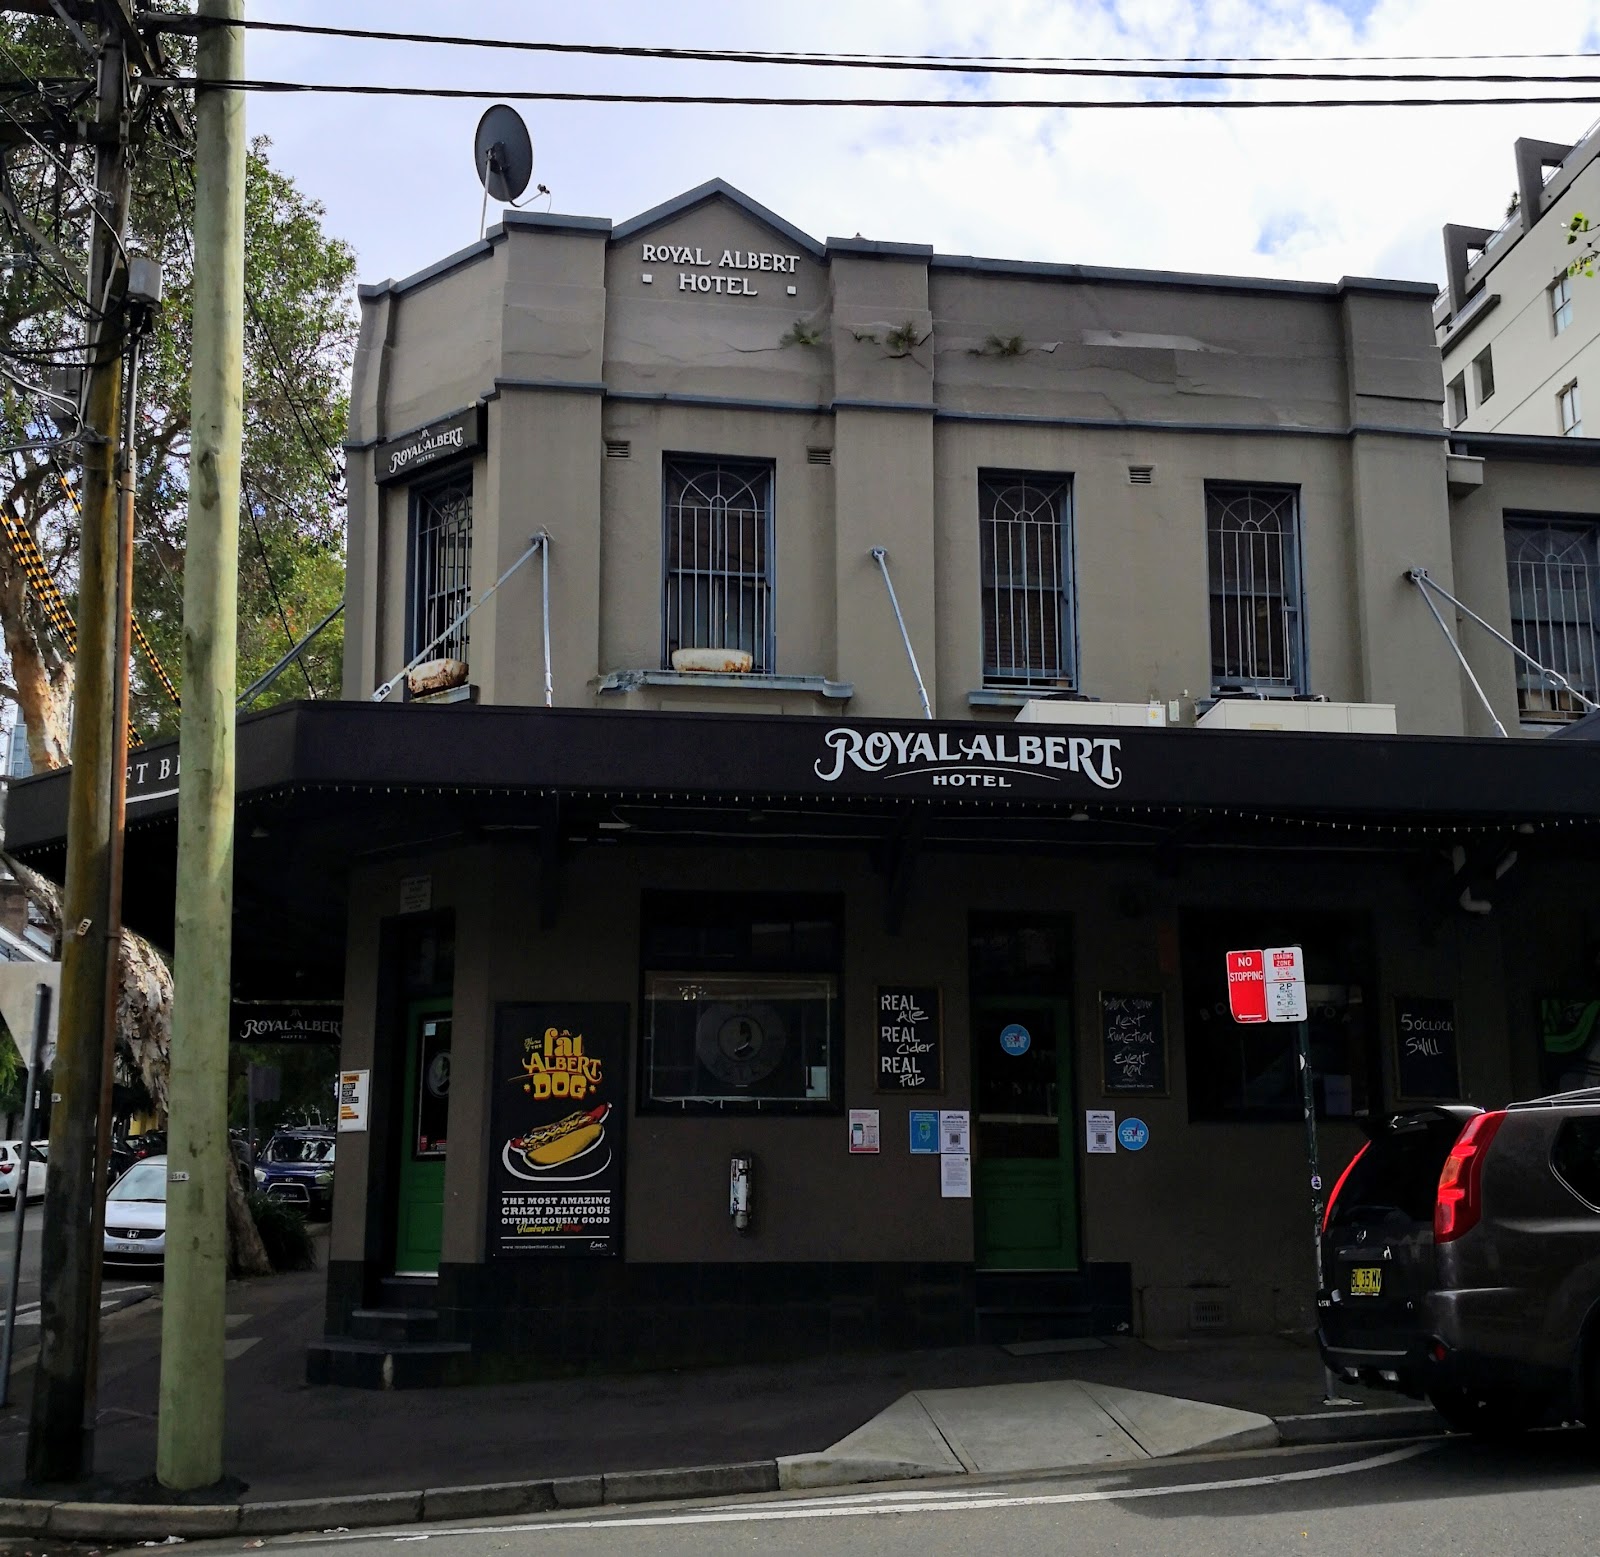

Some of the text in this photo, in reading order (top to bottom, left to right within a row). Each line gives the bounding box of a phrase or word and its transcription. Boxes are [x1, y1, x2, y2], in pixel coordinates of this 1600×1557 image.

[642, 244, 801, 273] ROYAL ALBERT
[678, 273, 758, 296] HOTEL
[389, 426, 464, 474] ROYAL ALBERT
[813, 727, 1122, 789] ROYAL ALBERT
[932, 774, 1012, 788] HOTEL
[1230, 957, 1264, 983] NO STOPPING
[881, 994, 920, 1010] REAL
[896, 1010, 929, 1024] Ale
[1400, 1013, 1413, 1031] 5
[240, 1019, 342, 1039] ROYAL ALBER
[881, 1026, 920, 1043] REAL
[522, 1052, 603, 1082] ALBERT
[881, 1056, 921, 1073] REAL
[533, 1071, 587, 1099] DOG
[1122, 1128, 1145, 1137] COVID
[502, 1196, 611, 1205] THE MOST AMAZING
[501, 1206, 611, 1215] CRAZY DELICIOUS
[501, 1216, 611, 1225] OUTRAGEOUSLY GOOD
